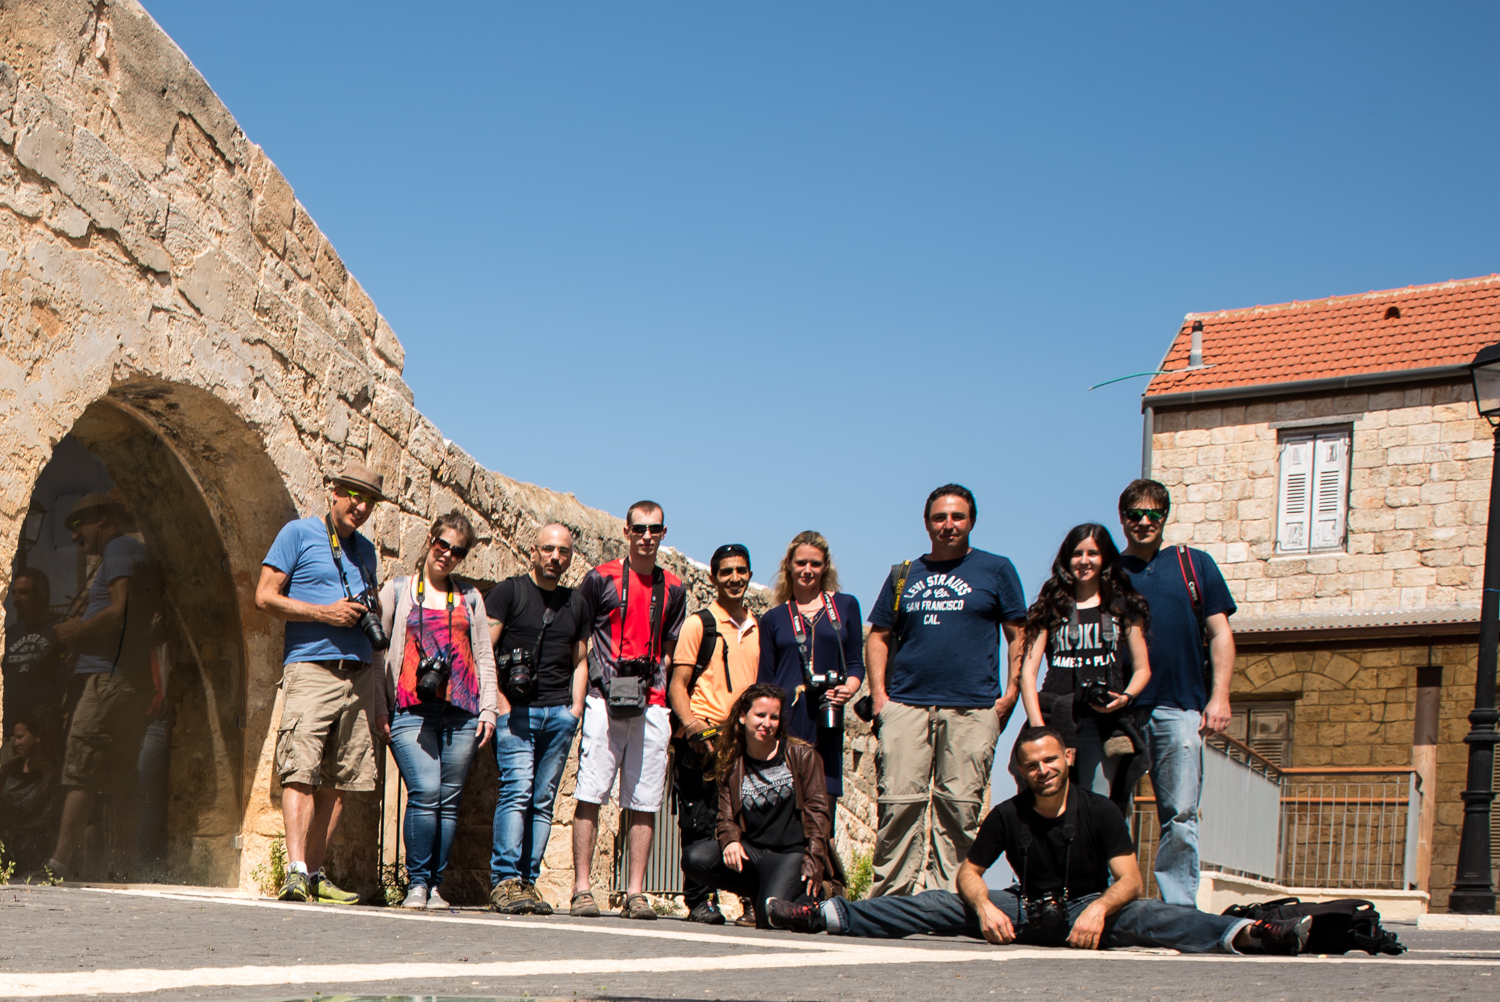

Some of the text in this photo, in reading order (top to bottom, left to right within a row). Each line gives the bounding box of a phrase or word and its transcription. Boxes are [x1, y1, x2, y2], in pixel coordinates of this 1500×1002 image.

[903, 573, 972, 599] LEVI STRAUSS
[905, 601, 920, 613] SAN
[920, 599, 965, 612] FRANCISCO
[923, 613, 941, 626] CAL.
